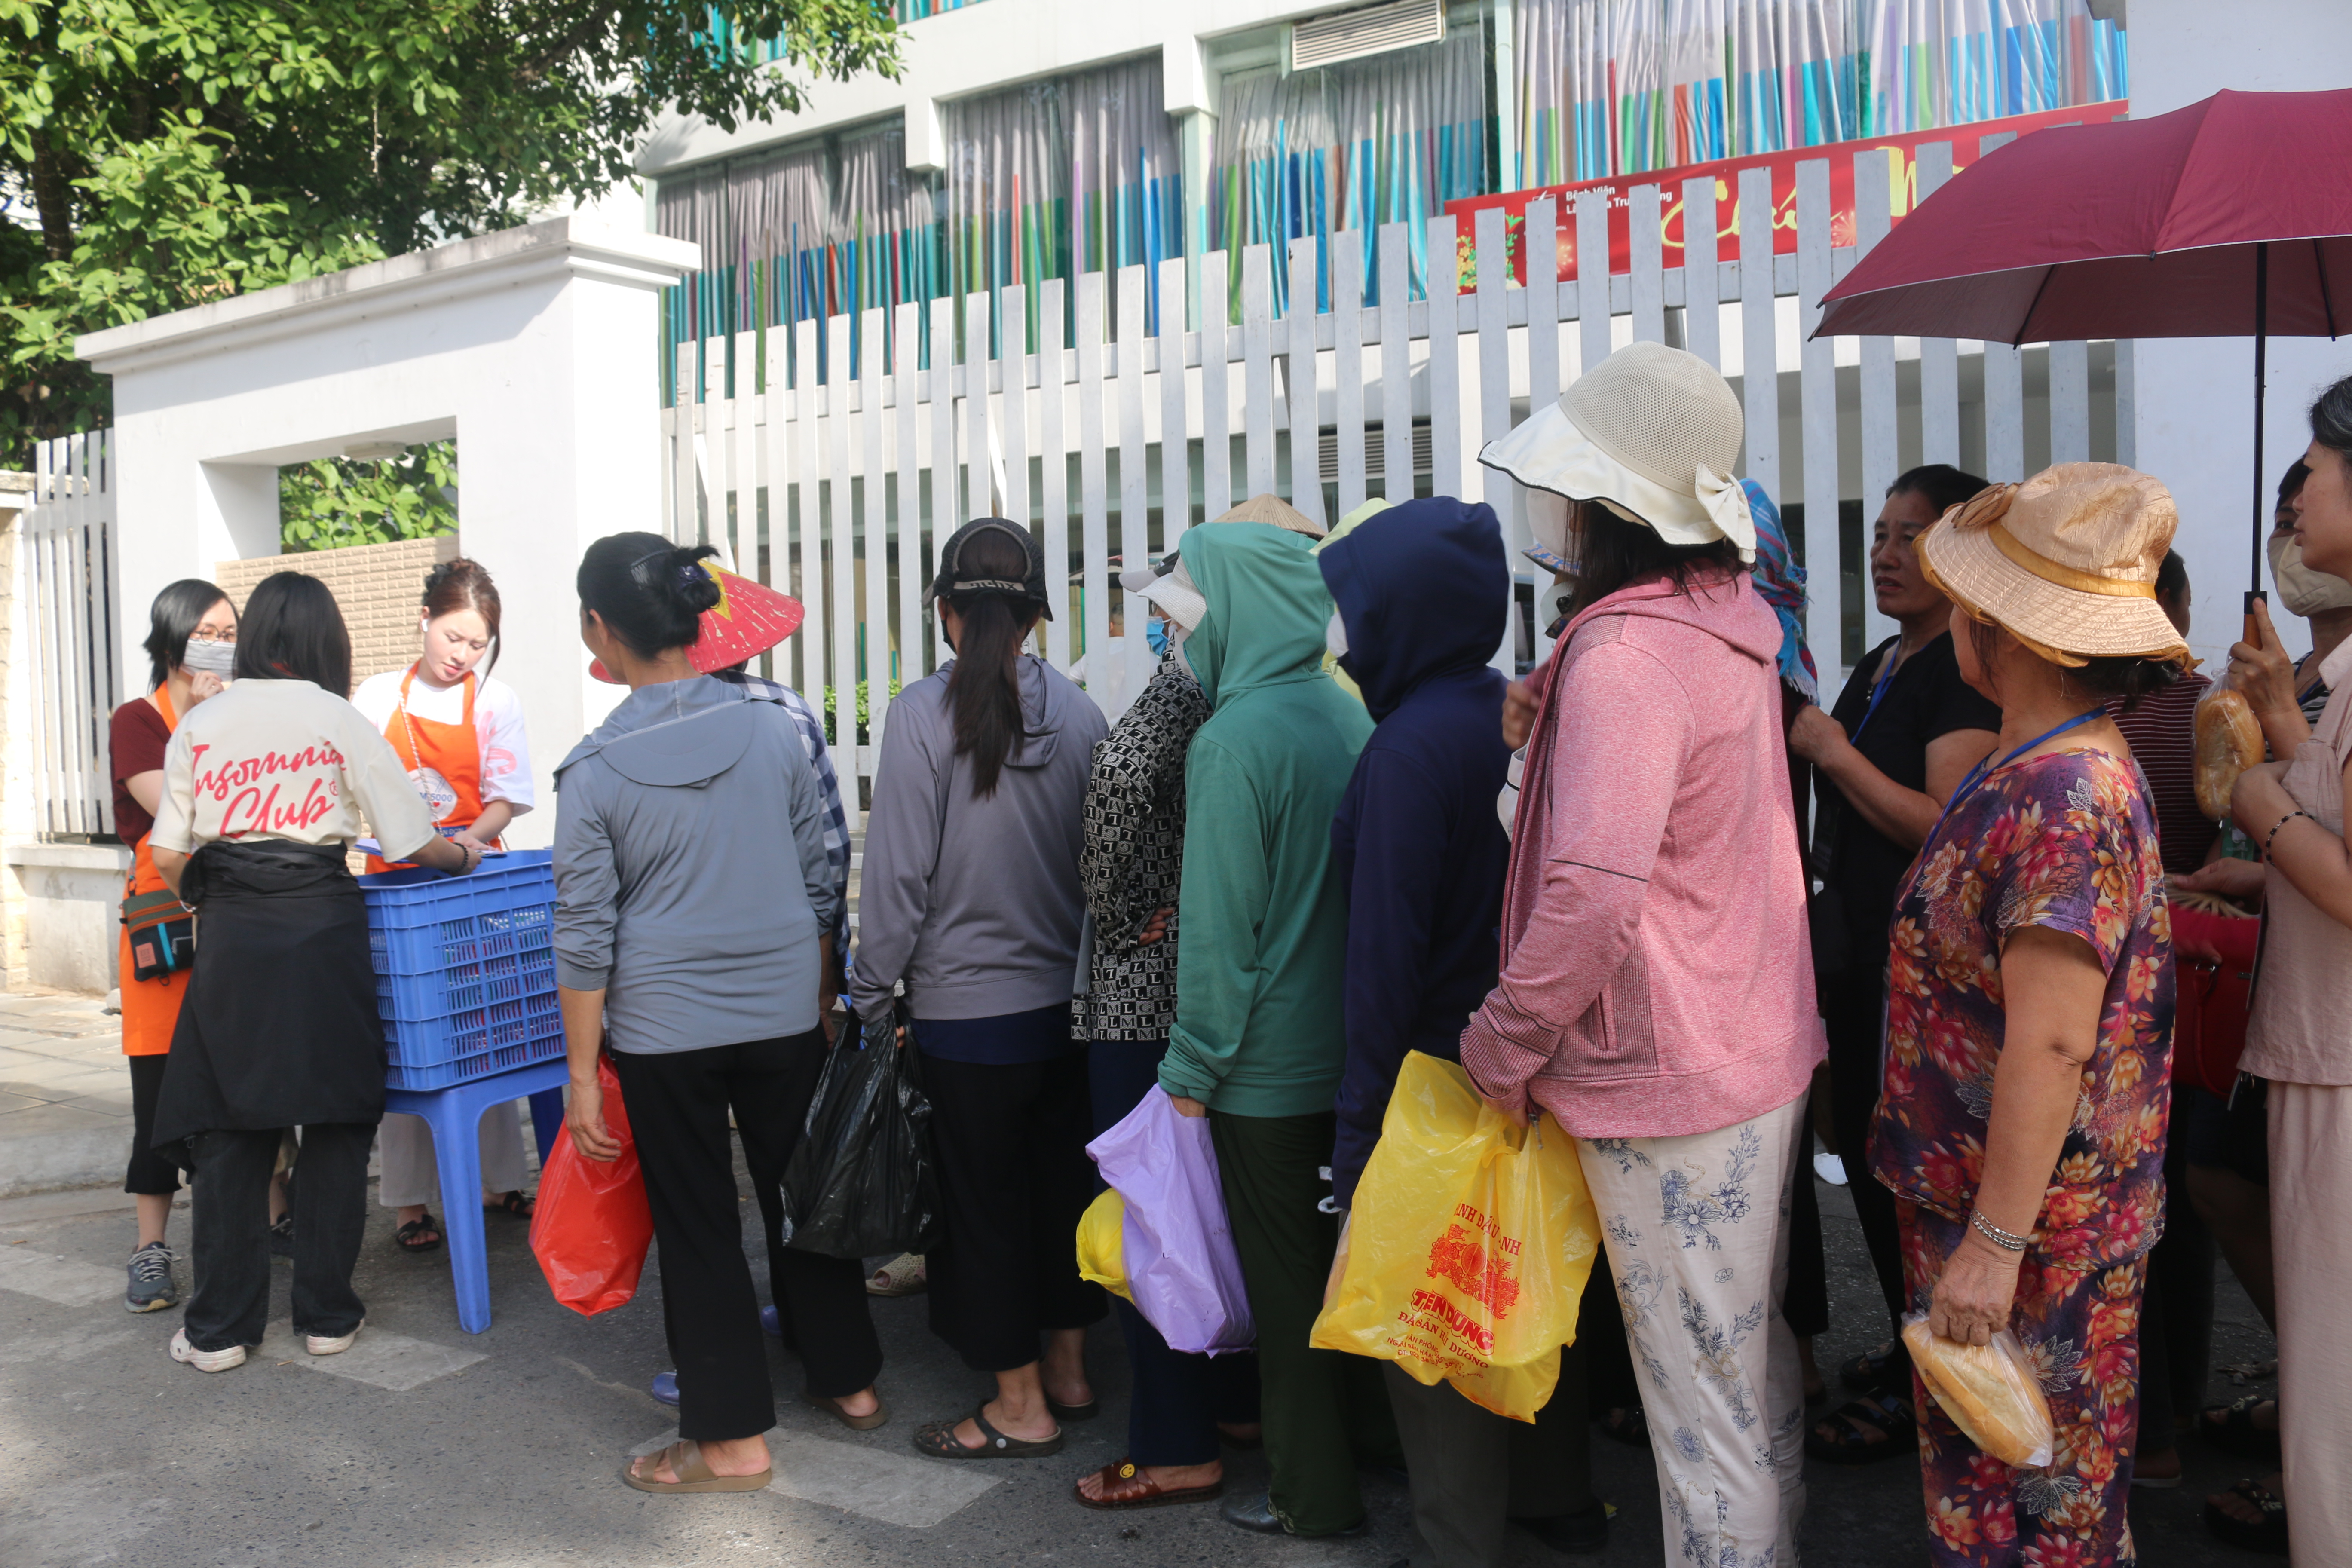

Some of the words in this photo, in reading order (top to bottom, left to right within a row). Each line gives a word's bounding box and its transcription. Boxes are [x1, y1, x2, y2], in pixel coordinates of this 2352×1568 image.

[192, 741, 346, 801] Insomnia
[220, 778, 334, 839] Club
[1449, 1342, 1488, 1368] DƯƠNG
